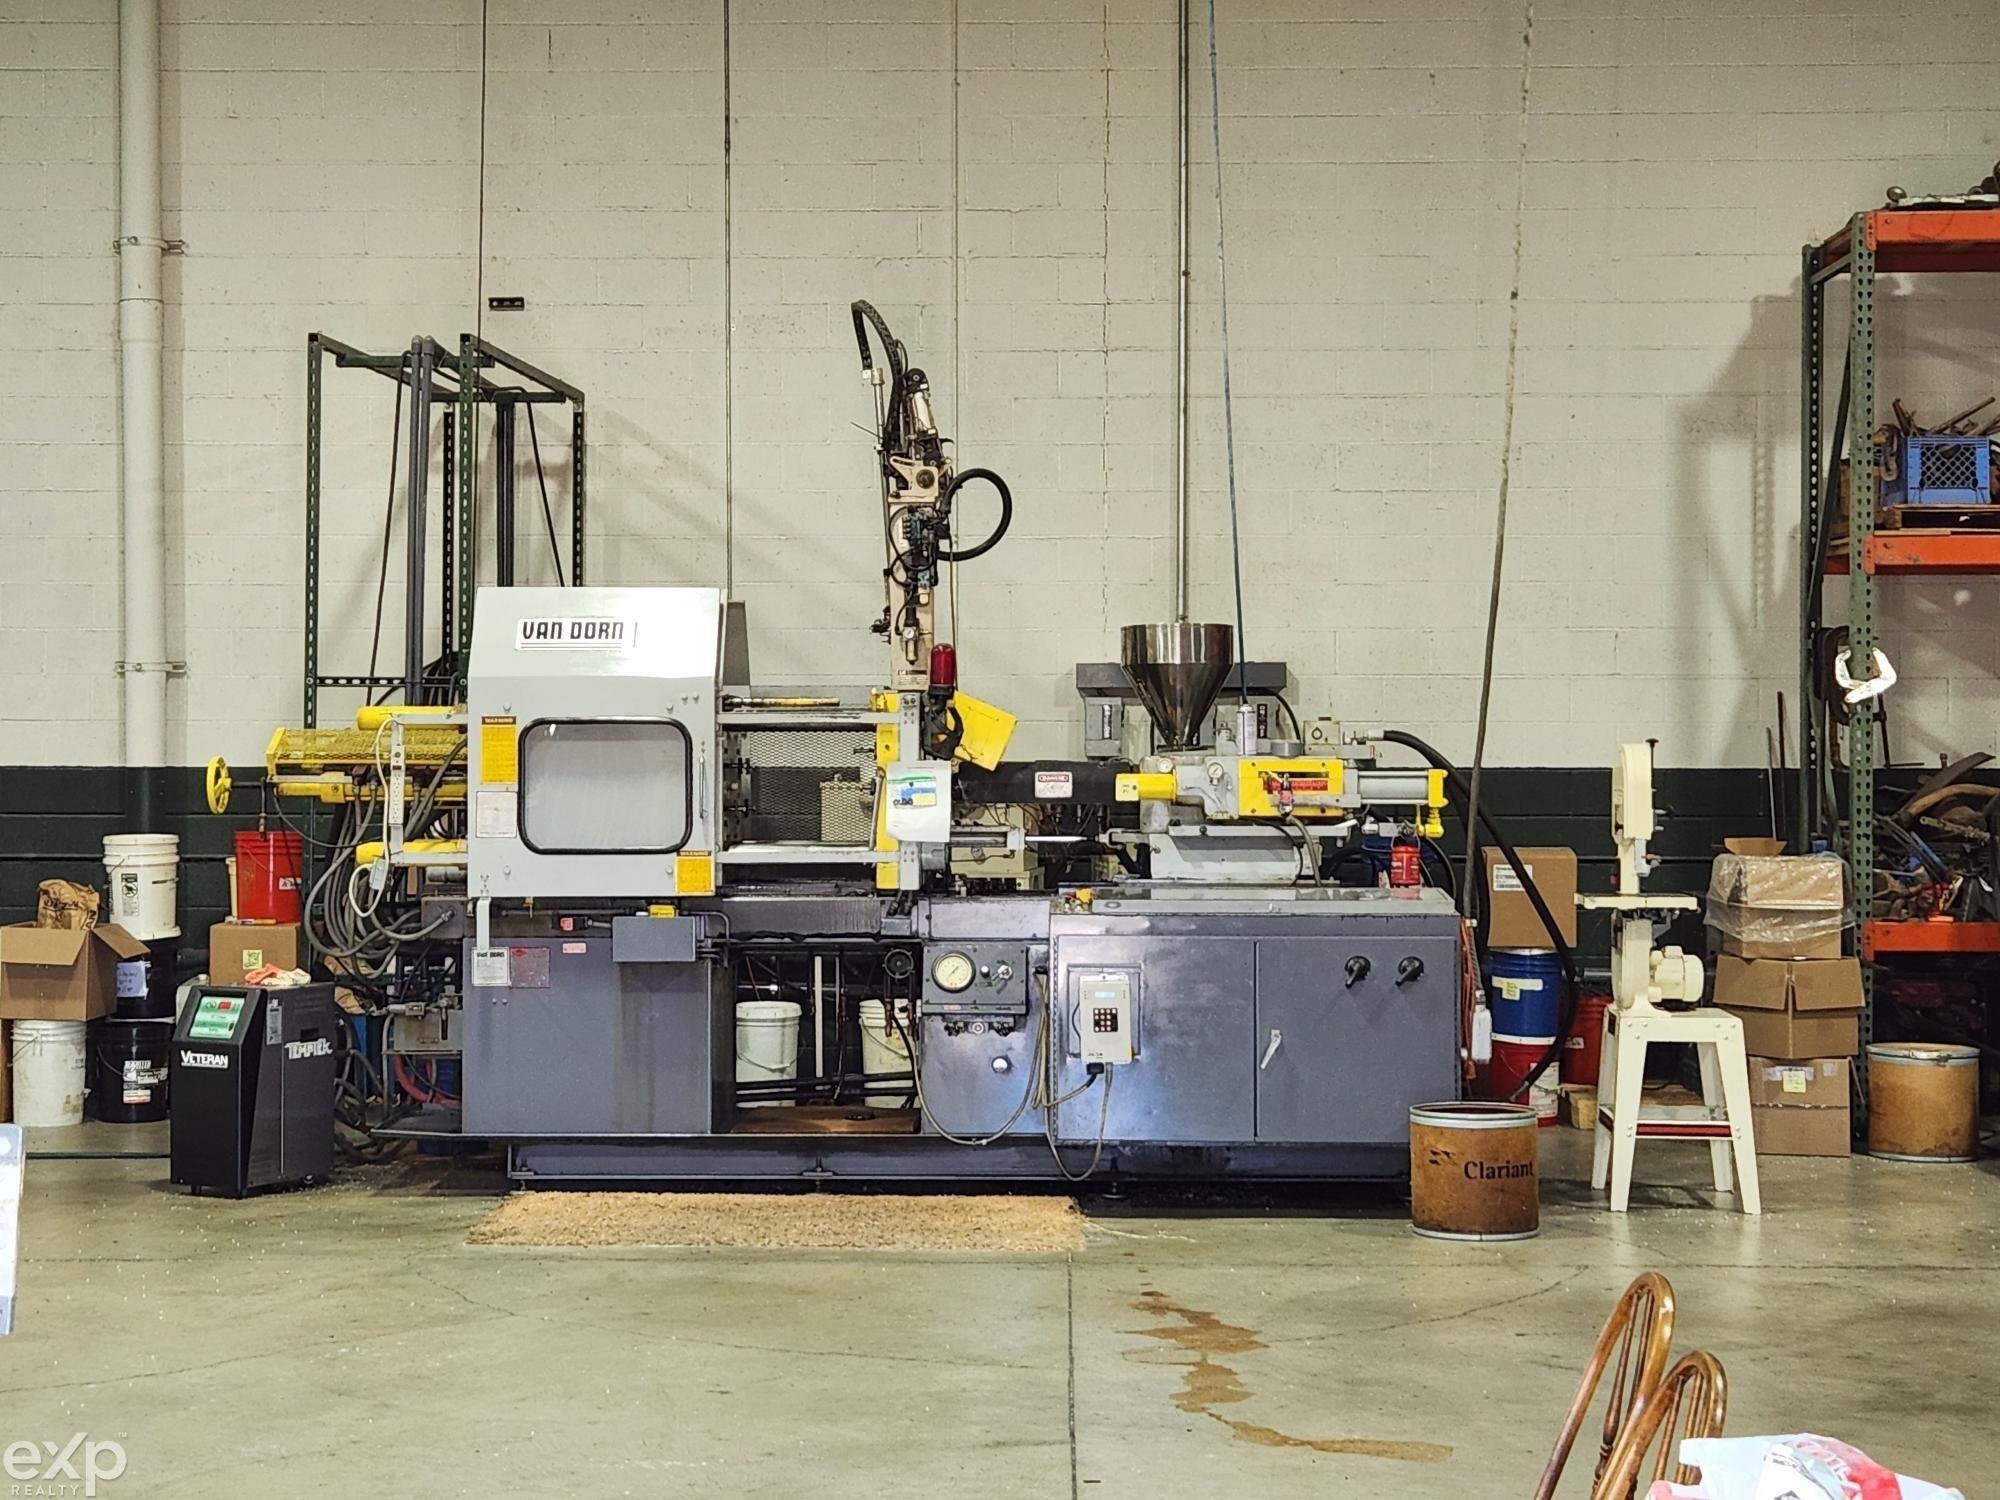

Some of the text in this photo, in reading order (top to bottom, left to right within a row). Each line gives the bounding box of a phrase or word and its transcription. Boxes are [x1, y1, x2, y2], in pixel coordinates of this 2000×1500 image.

[523, 621, 624, 640] VAN DORN
[180, 1050, 229, 1067] VETERAN
[1464, 1160, 1534, 1180] Clariant
